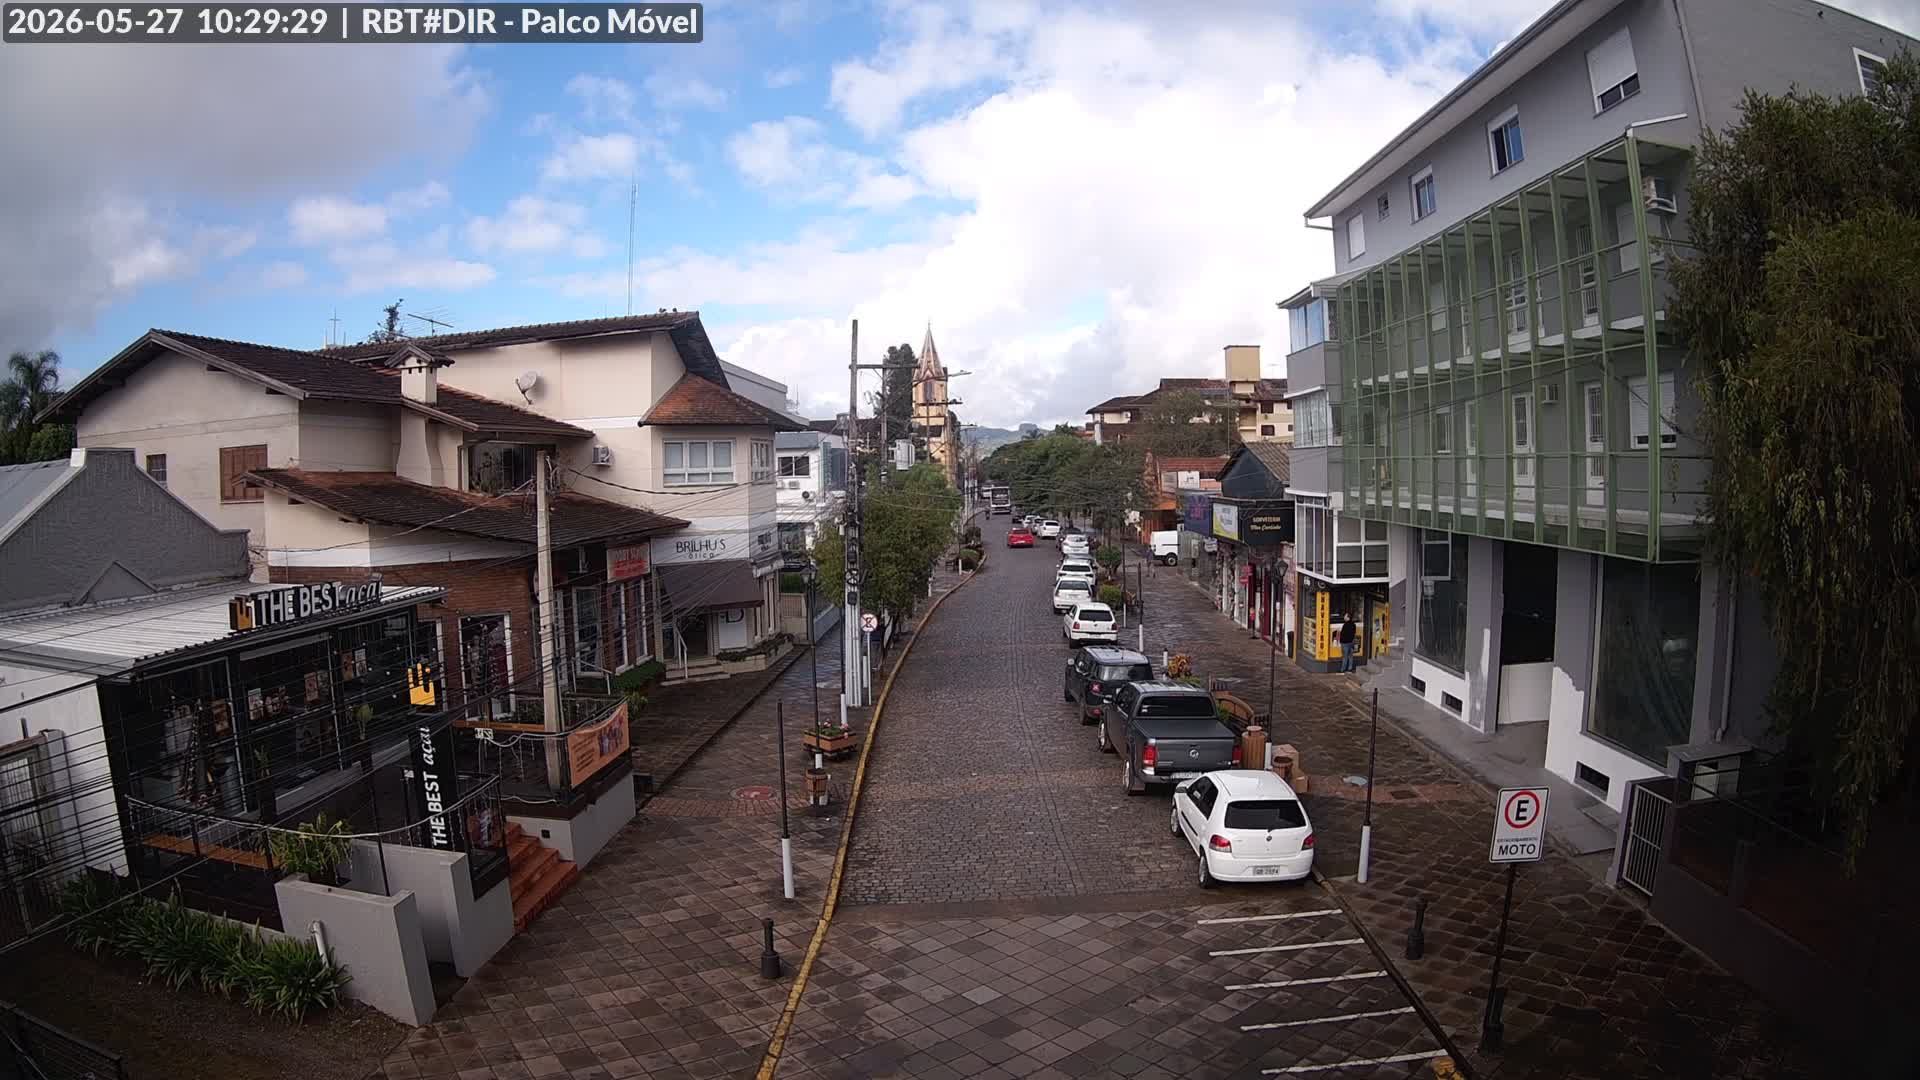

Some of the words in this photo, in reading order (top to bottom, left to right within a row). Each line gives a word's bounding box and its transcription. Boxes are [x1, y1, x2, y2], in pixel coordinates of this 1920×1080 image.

[676, 539, 726, 553] BRILHUS
[258, 590, 295, 626] THE
[299, 582, 341, 618] BEST
[423, 771, 443, 813] BEST
[1515, 800, 1529, 821] E
[430, 818, 448, 846] THE
[1498, 844, 1536, 856] MOTO
